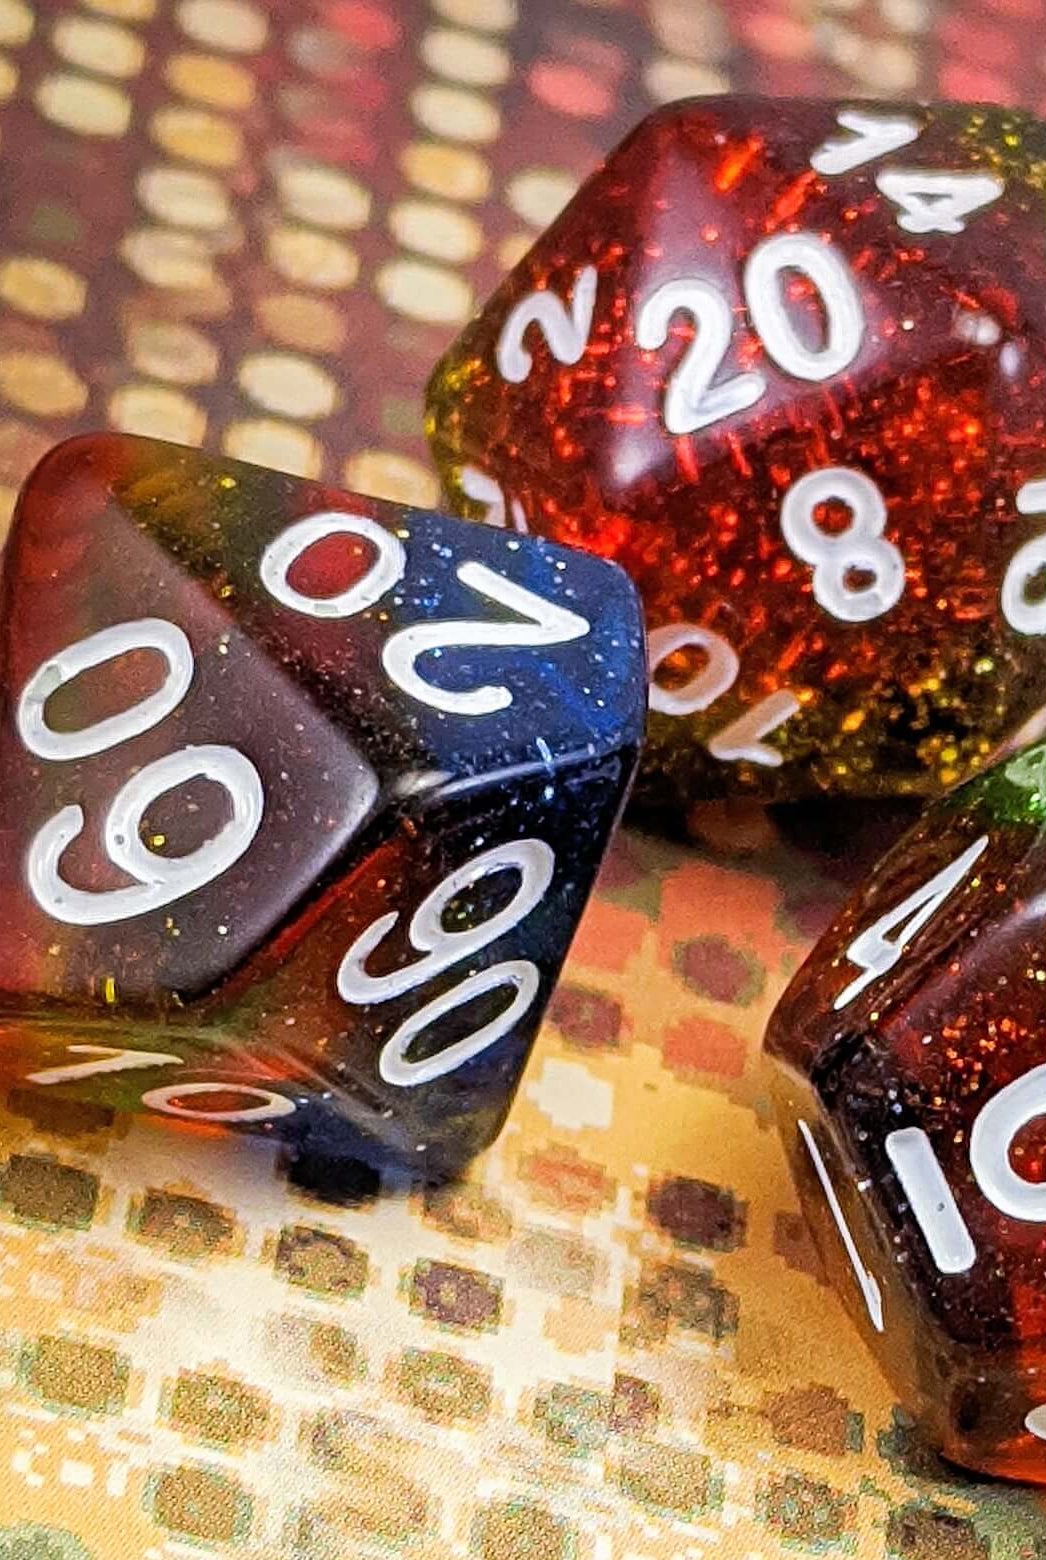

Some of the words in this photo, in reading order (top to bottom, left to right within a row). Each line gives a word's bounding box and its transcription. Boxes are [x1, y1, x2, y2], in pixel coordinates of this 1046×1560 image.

[810, 110, 1003, 233] 14
[498, 266, 597, 383] 2
[636, 232, 864, 434] 20
[260, 512, 590, 715] 20
[781, 467, 905, 621] 8
[834, 836, 989, 1009] 4
